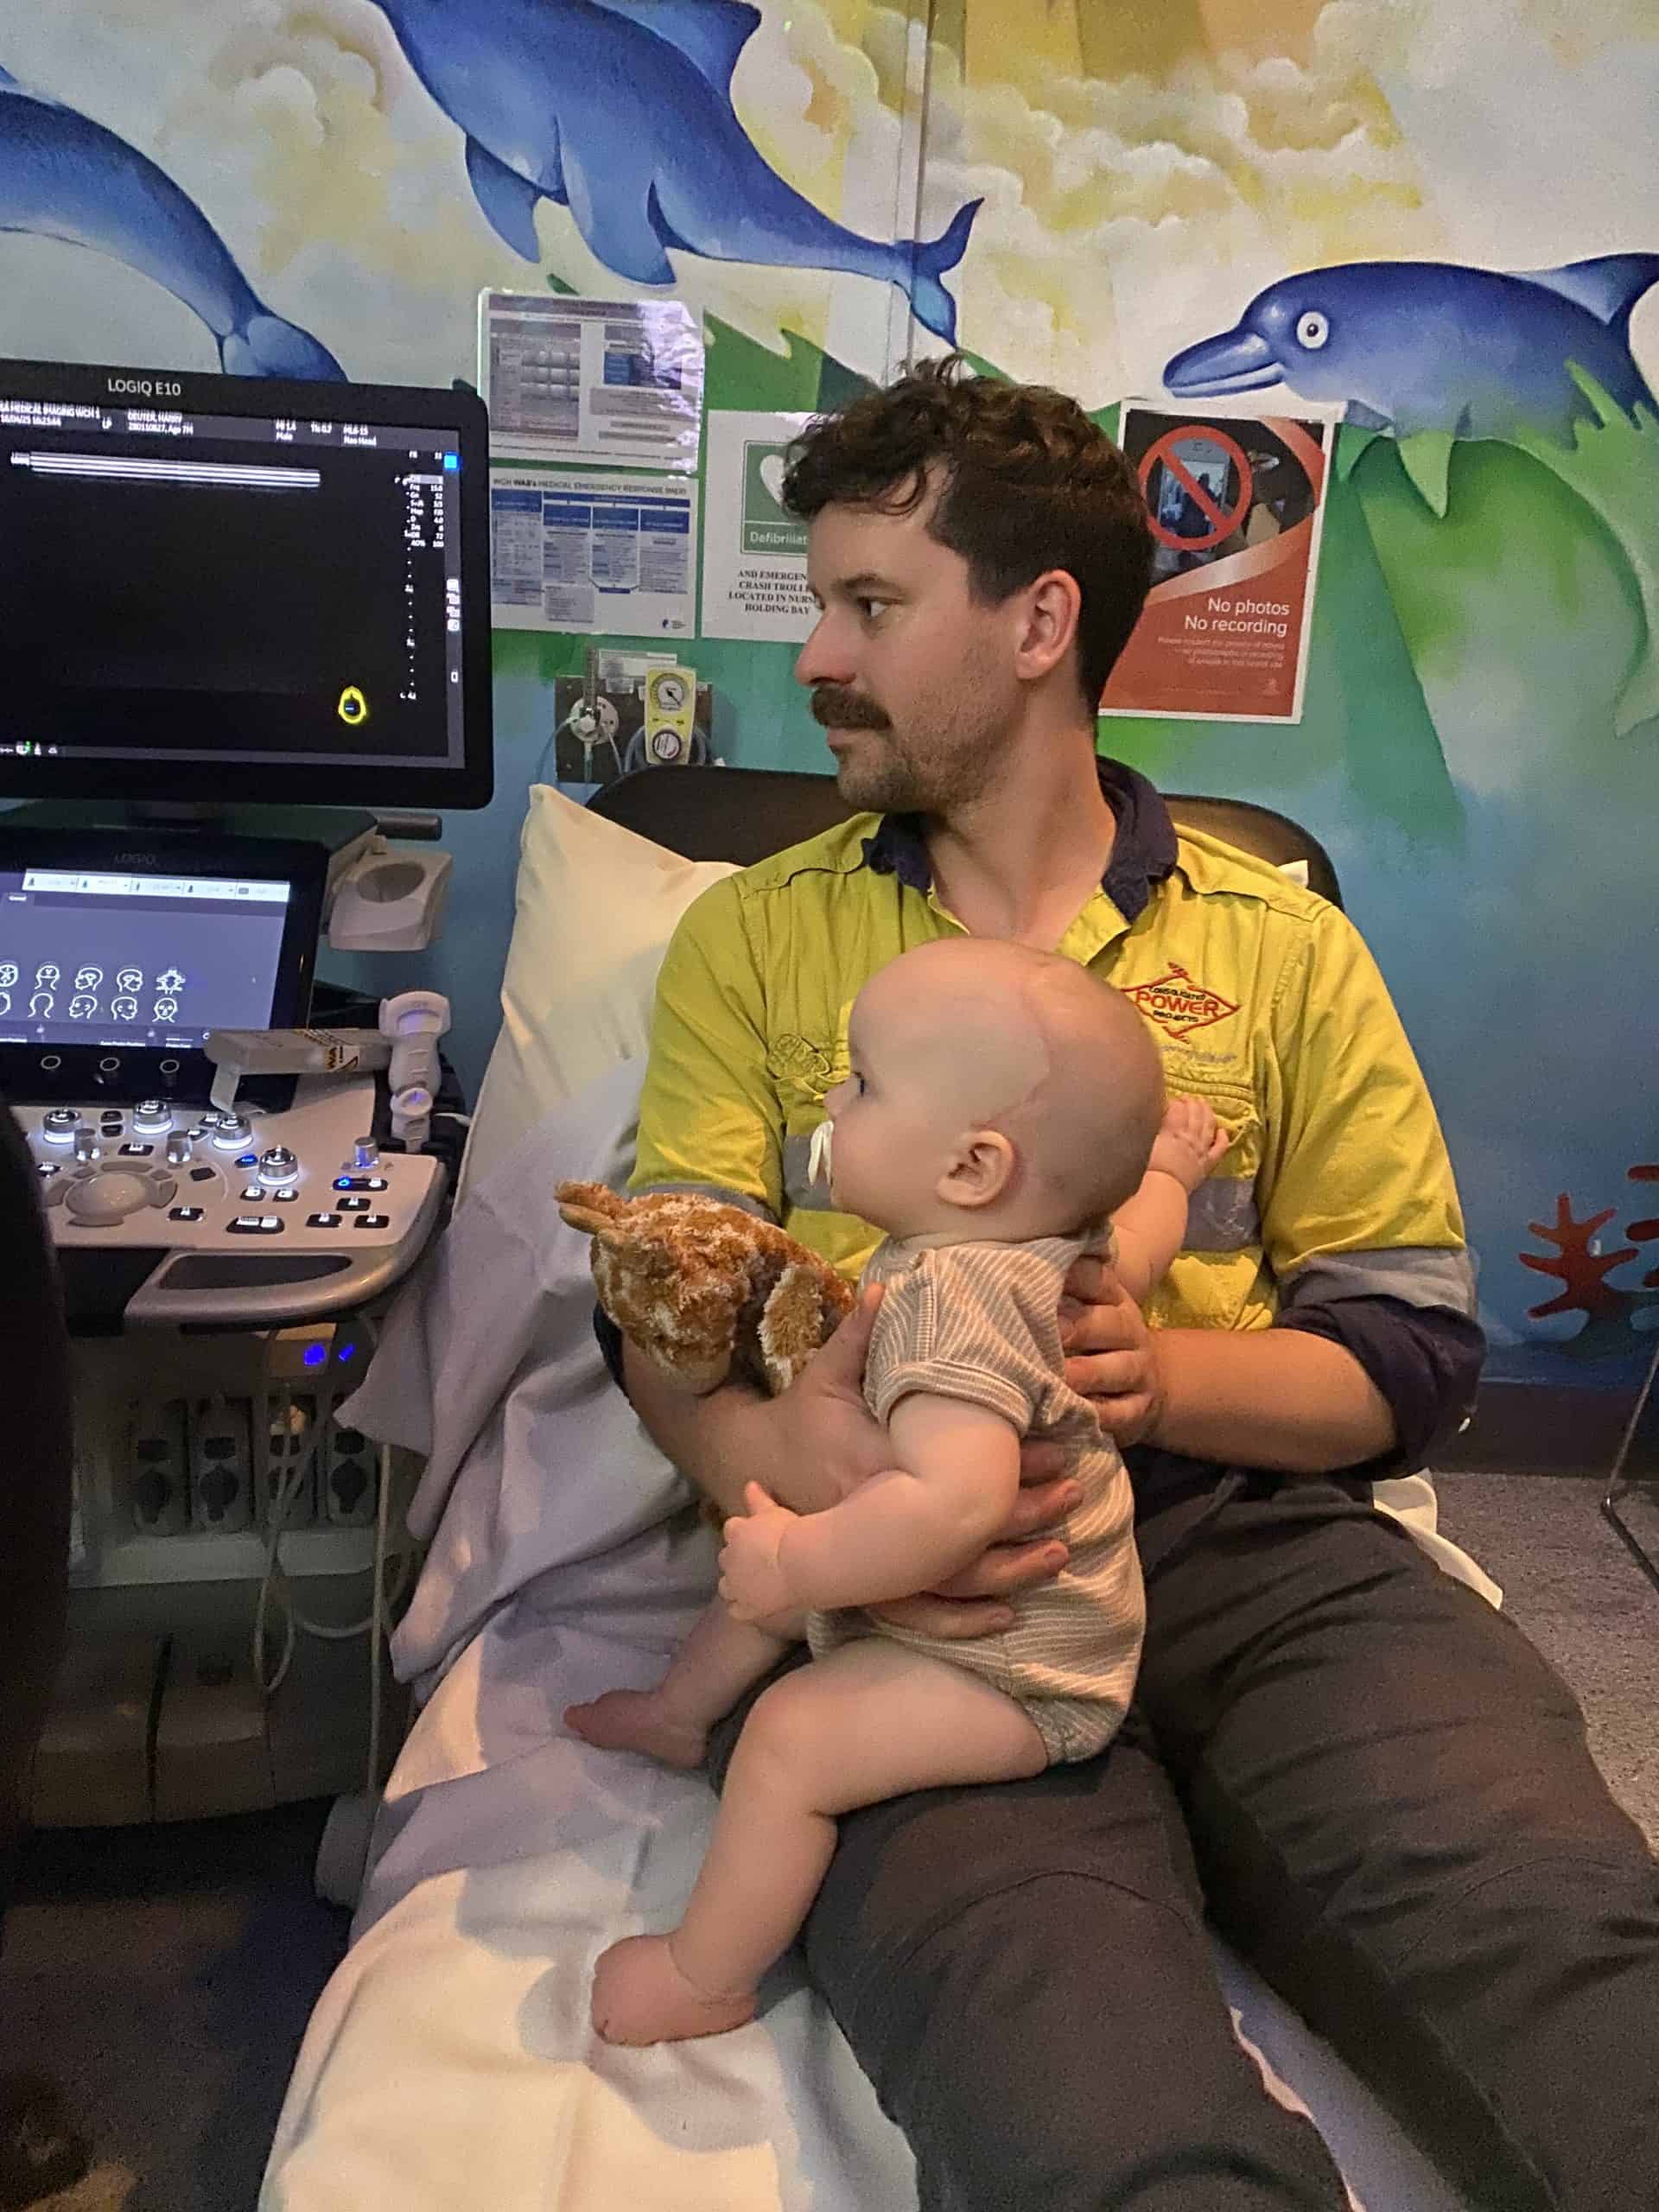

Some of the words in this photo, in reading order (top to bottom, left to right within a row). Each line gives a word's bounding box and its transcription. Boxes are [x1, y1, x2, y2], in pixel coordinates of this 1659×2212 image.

[108, 378, 152, 396] LOGIQ
[156, 382, 181, 396] E10
[537, 480, 573, 490] MEDICAL
[623, 484, 664, 493] RESPONSE
[738, 570, 759, 579] AND
[739, 582, 772, 591] CRASH
[728, 592, 774, 602] LOCATED
[776, 594, 787, 602] IN
[745, 603, 788, 614] HOLDING
[791, 605, 810, 615] BAY
[1208, 597, 1230, 612] No
[1235, 599, 1290, 616] photos
[1185, 615, 1207, 630] No
[1211, 619, 1287, 637] recording
[1135, 991, 1219, 1017] POWER
[1154, 1010, 1199, 1022] PROJECTS
